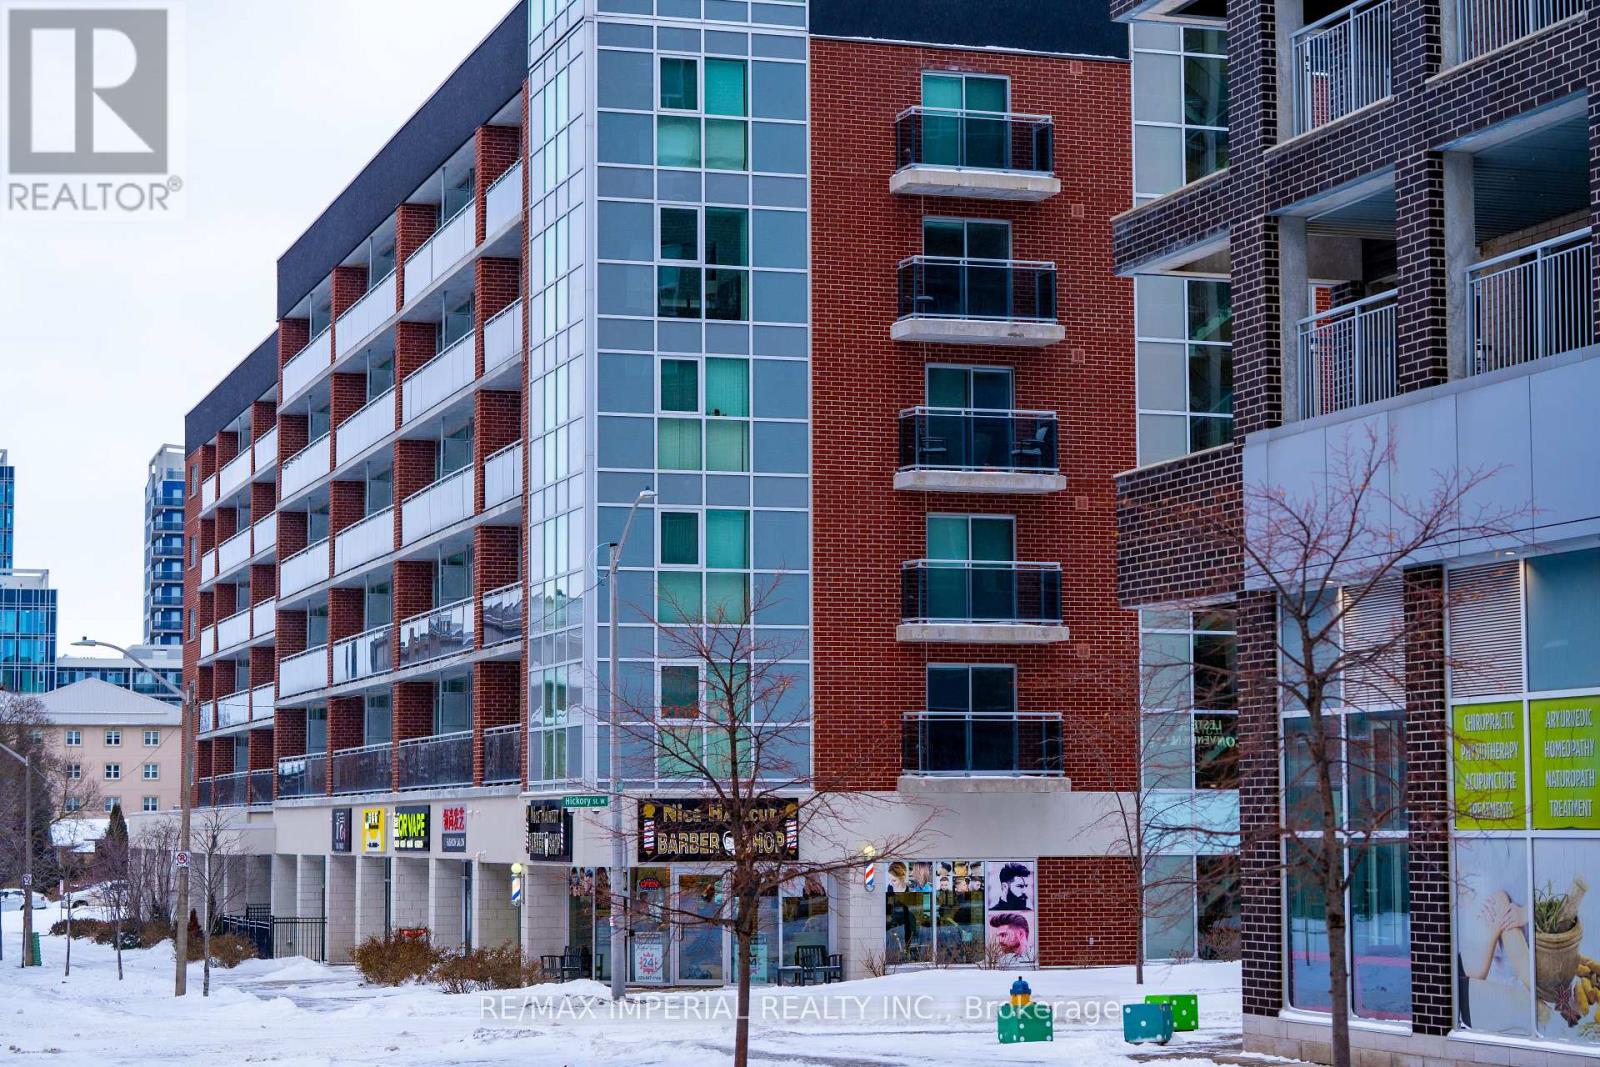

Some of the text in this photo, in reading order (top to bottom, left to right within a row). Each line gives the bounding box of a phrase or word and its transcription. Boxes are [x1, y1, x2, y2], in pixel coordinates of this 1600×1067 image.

[1464, 711, 1515, 731] CHIROPRACTIC
[1461, 741, 1519, 761] PHYSIOTHERAPY
[1544, 739, 1595, 758] HOMEOPATHY
[1464, 771, 1517, 790] ACUPUNCTURE
[1546, 769, 1596, 788] NATUROPATH
[565, 796, 590, 806] Hickory
[1549, 799, 1593, 817] TREATMENT
[657, 832, 720, 854] BARBER
[640, 880, 659, 888] OPEN
[643, 958, 654, 968] 24
